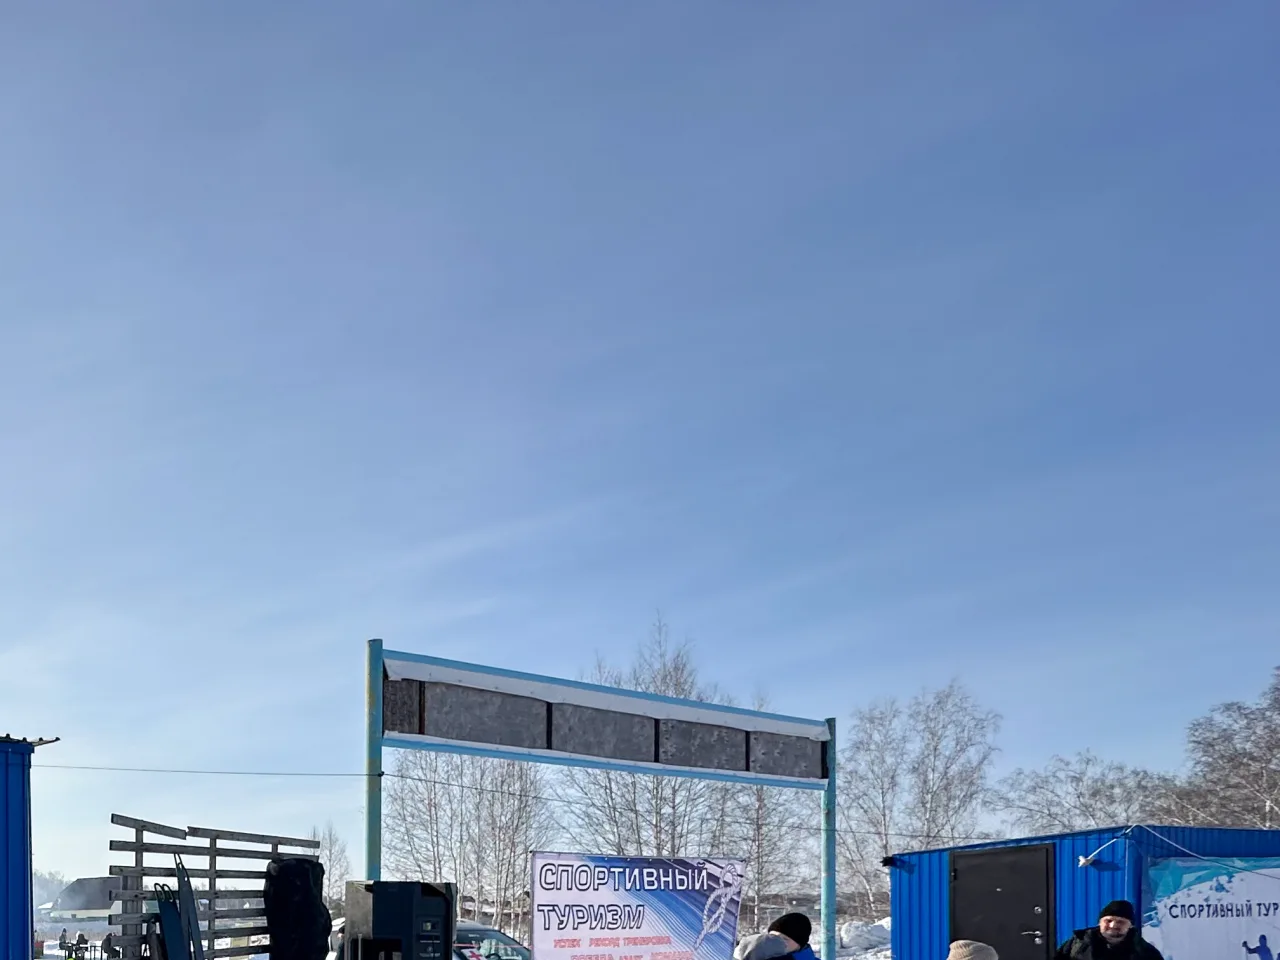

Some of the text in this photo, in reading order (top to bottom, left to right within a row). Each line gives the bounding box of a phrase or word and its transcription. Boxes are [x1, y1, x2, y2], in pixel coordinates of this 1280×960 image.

[539, 862, 708, 891] СПОРТИВНЫЙ
[537, 904, 645, 931] ТУРИЗМ
[1169, 900, 1253, 918] СПОРТИВНЫЙ
